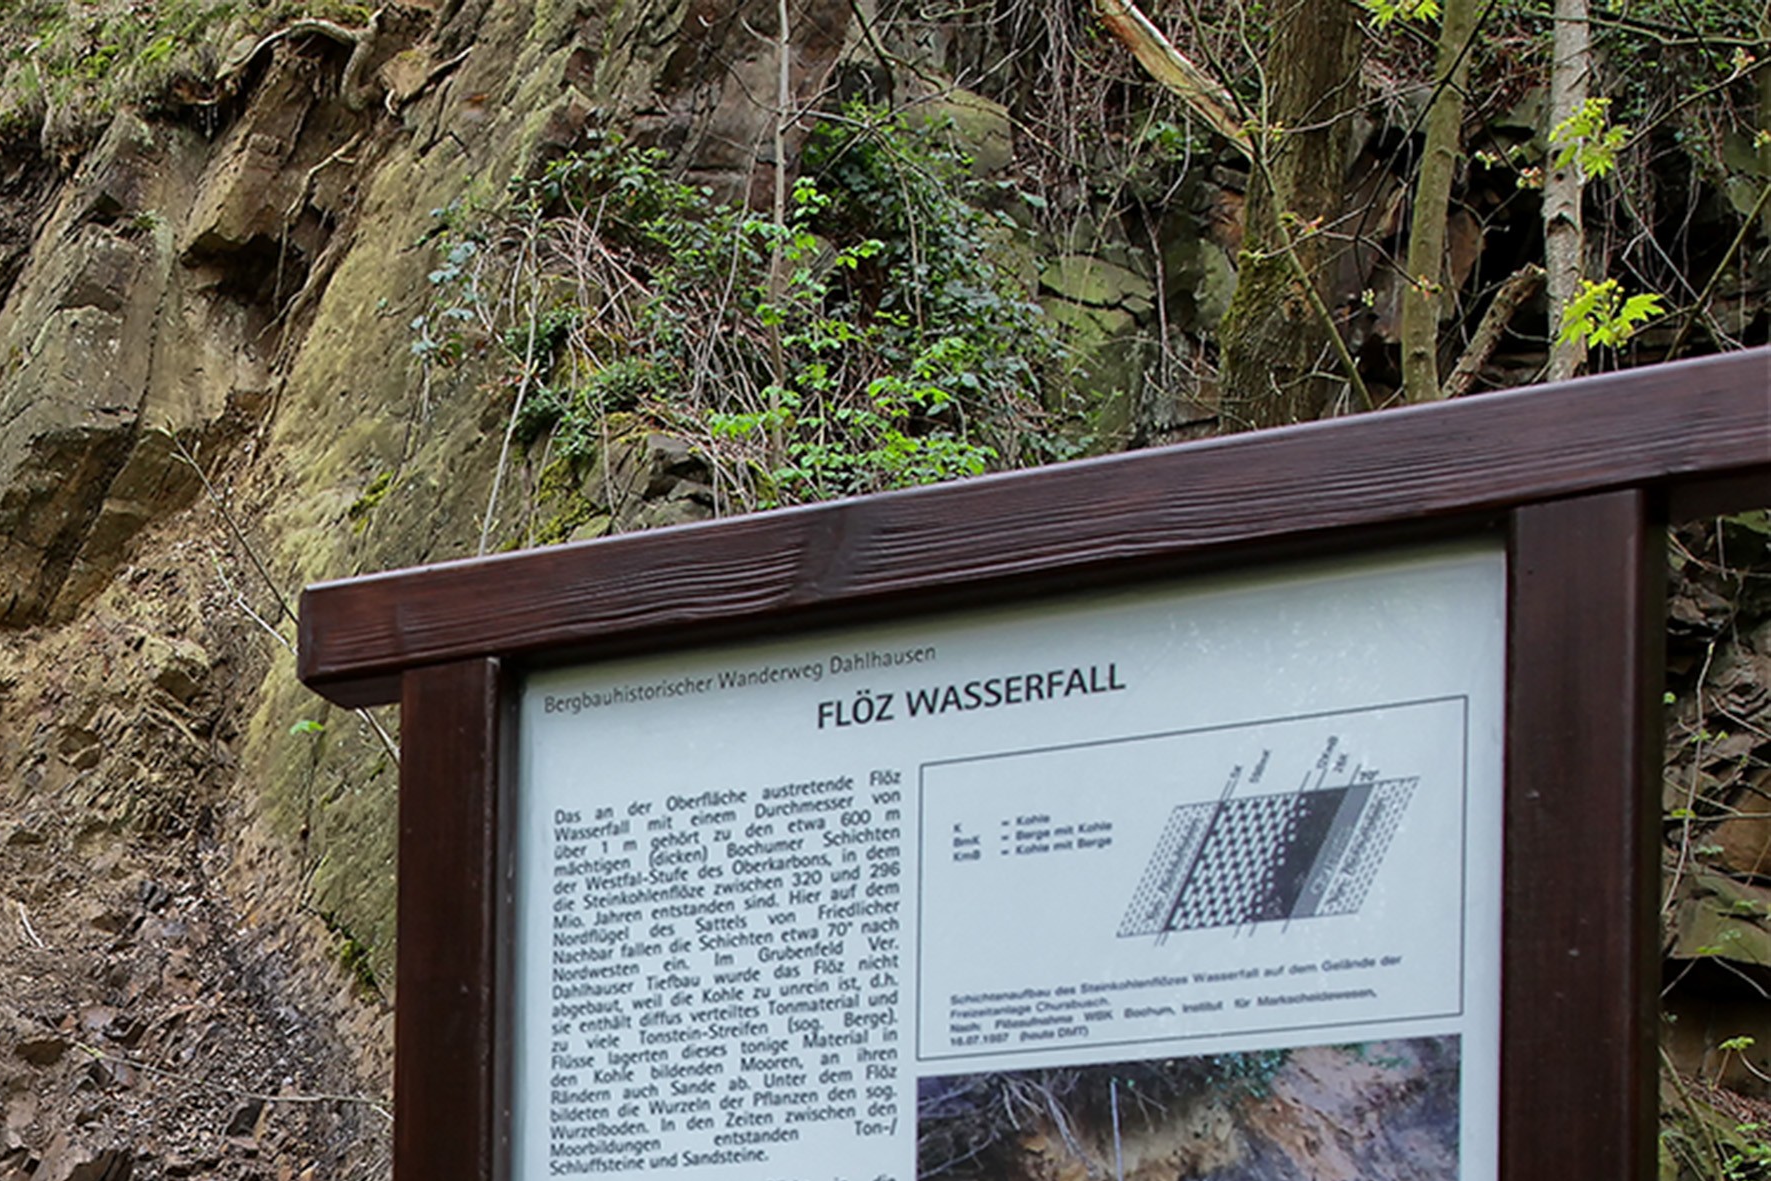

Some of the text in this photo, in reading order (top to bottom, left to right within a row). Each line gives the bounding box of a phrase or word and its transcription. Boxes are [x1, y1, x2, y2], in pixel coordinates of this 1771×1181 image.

[544, 646, 936, 716] Bergbauhistorischer Wanderweg Dahlhausen
[817, 663, 1126, 729] FLÖZ WASSERFALL
[553, 790, 902, 842] Wasserfall mit einem Durchmesser von
[554, 769, 902, 824] Das an der Oberfläche austretende Flöz
[1015, 814, 1051, 827] Kohle
[1014, 828, 1051, 842] Berge
[1053, 825, 1075, 837] mit
[1077, 821, 1113, 834] Kohle
[1015, 840, 1050, 856] Kohle
[1052, 839, 1073, 851] mit
[1076, 836, 1113, 850] Berge
[552, 860, 901, 912] die Steinkohlenflöze zwischen 320 und 296
[552, 881, 901, 929] Mio. Jahren entstanden sind. Hier auf dem
[949, 988, 1052, 1006] Schichtenaufbau
[1054, 985, 1077, 997] des
[1192, 967, 1260, 983] Wasserfall
[1263, 965, 1285, 978] auf
[1288, 963, 1318, 976] dem
[1320, 957, 1377, 973] Gelände
[1379, 955, 1402, 967] der
[1233, 998, 1252, 1009] für
[949, 1004, 1033, 1019] Freizeitanlage
